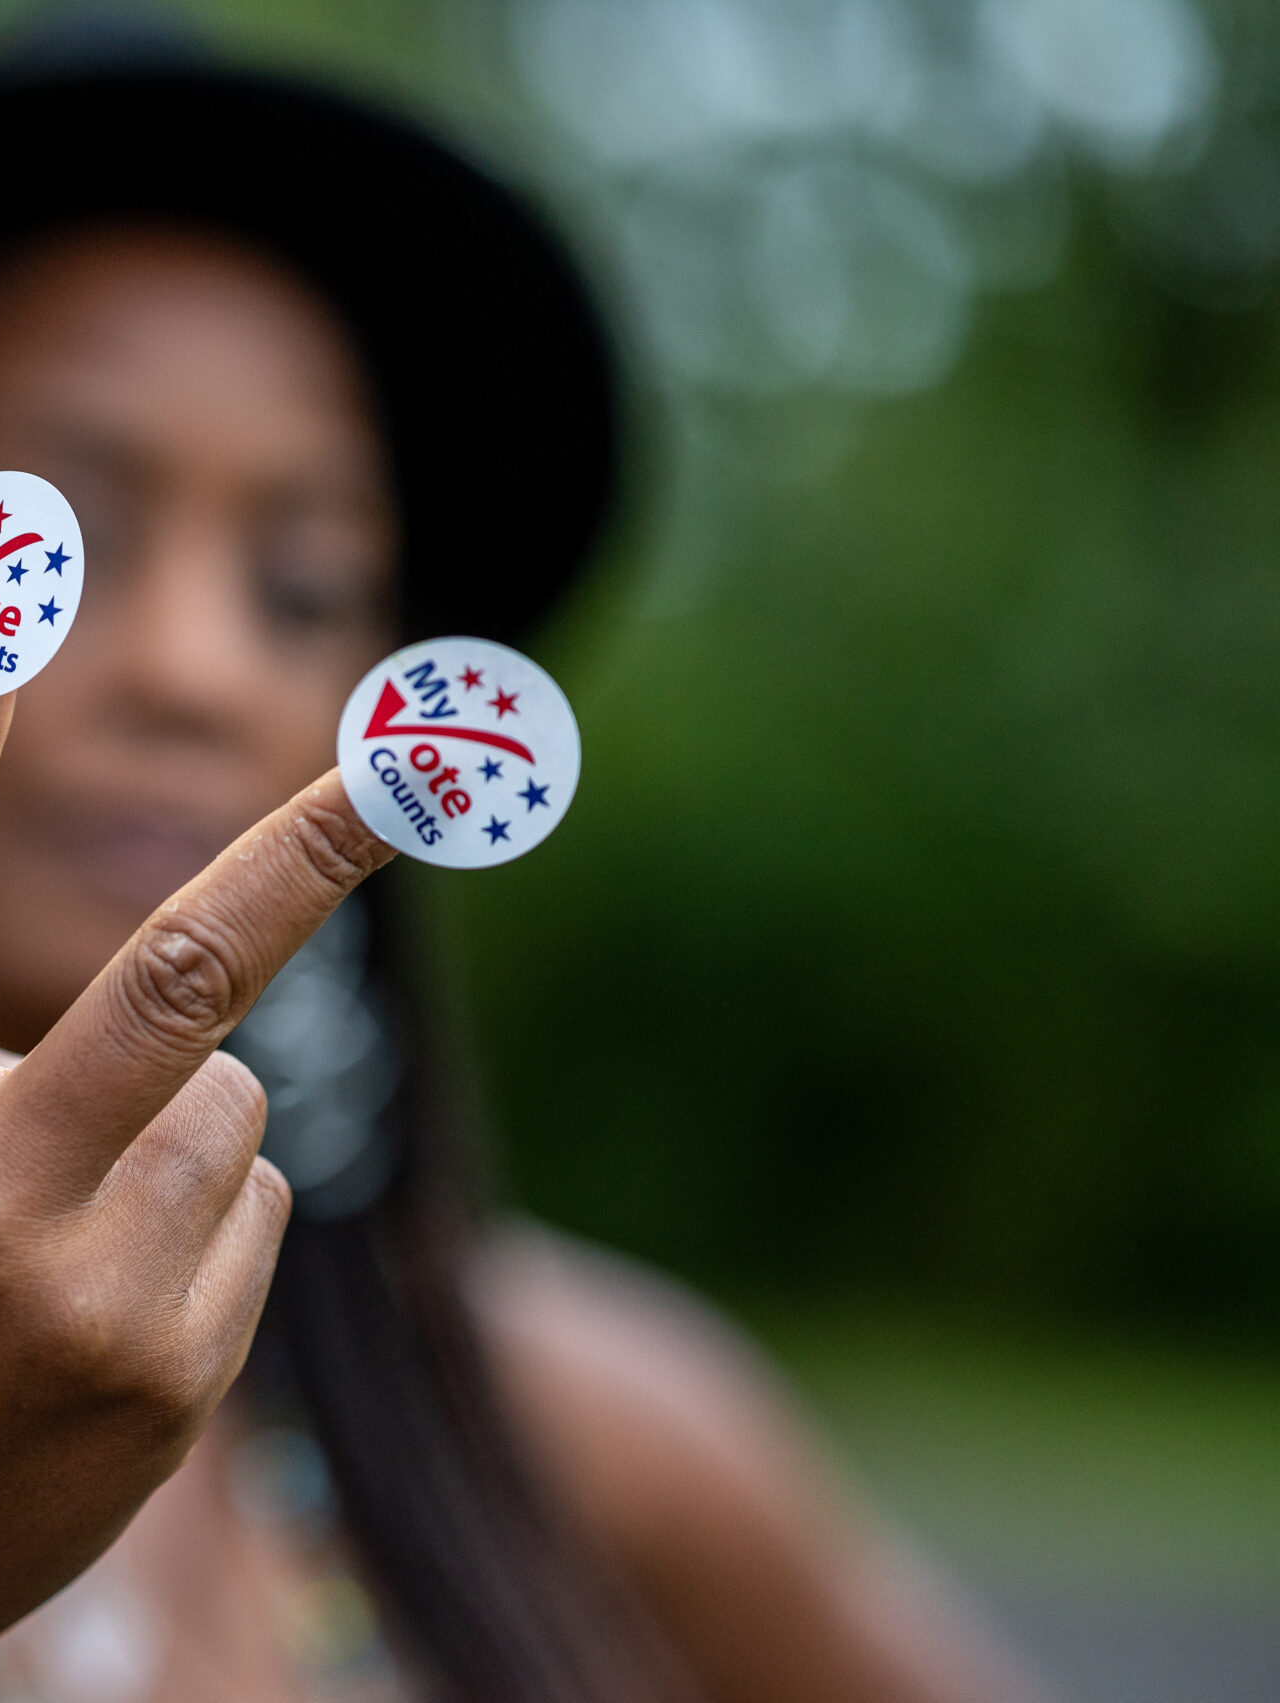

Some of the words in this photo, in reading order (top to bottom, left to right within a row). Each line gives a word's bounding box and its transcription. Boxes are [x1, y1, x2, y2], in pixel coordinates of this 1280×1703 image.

[403, 660, 459, 720] My
[362, 677, 536, 820] Vote
[369, 748, 444, 846] Counts
